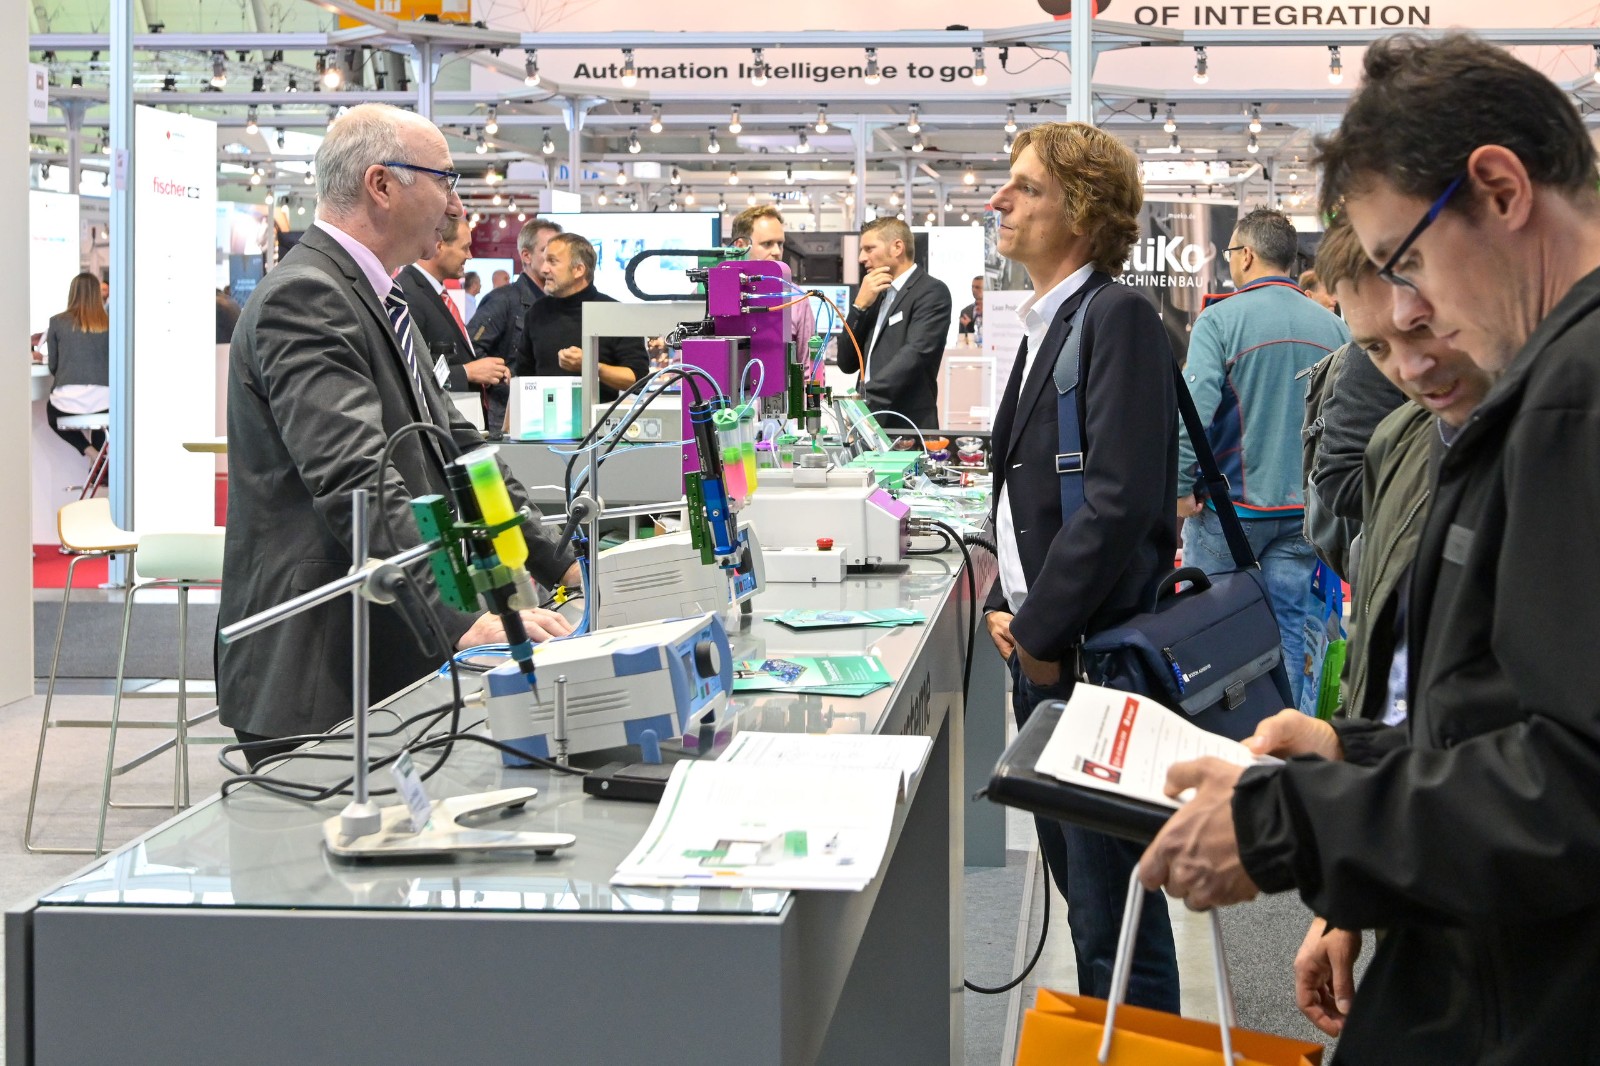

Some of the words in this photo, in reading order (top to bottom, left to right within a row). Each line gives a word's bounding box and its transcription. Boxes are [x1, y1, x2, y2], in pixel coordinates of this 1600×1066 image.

[1134, 6, 1180, 25] OF
[1194, 6, 1431, 25] INTEGRATION
[907, 62, 934, 79] to
[940, 65, 974, 82] go
[153, 176, 186, 197] fischer
[1123, 235, 1205, 273] üKo
